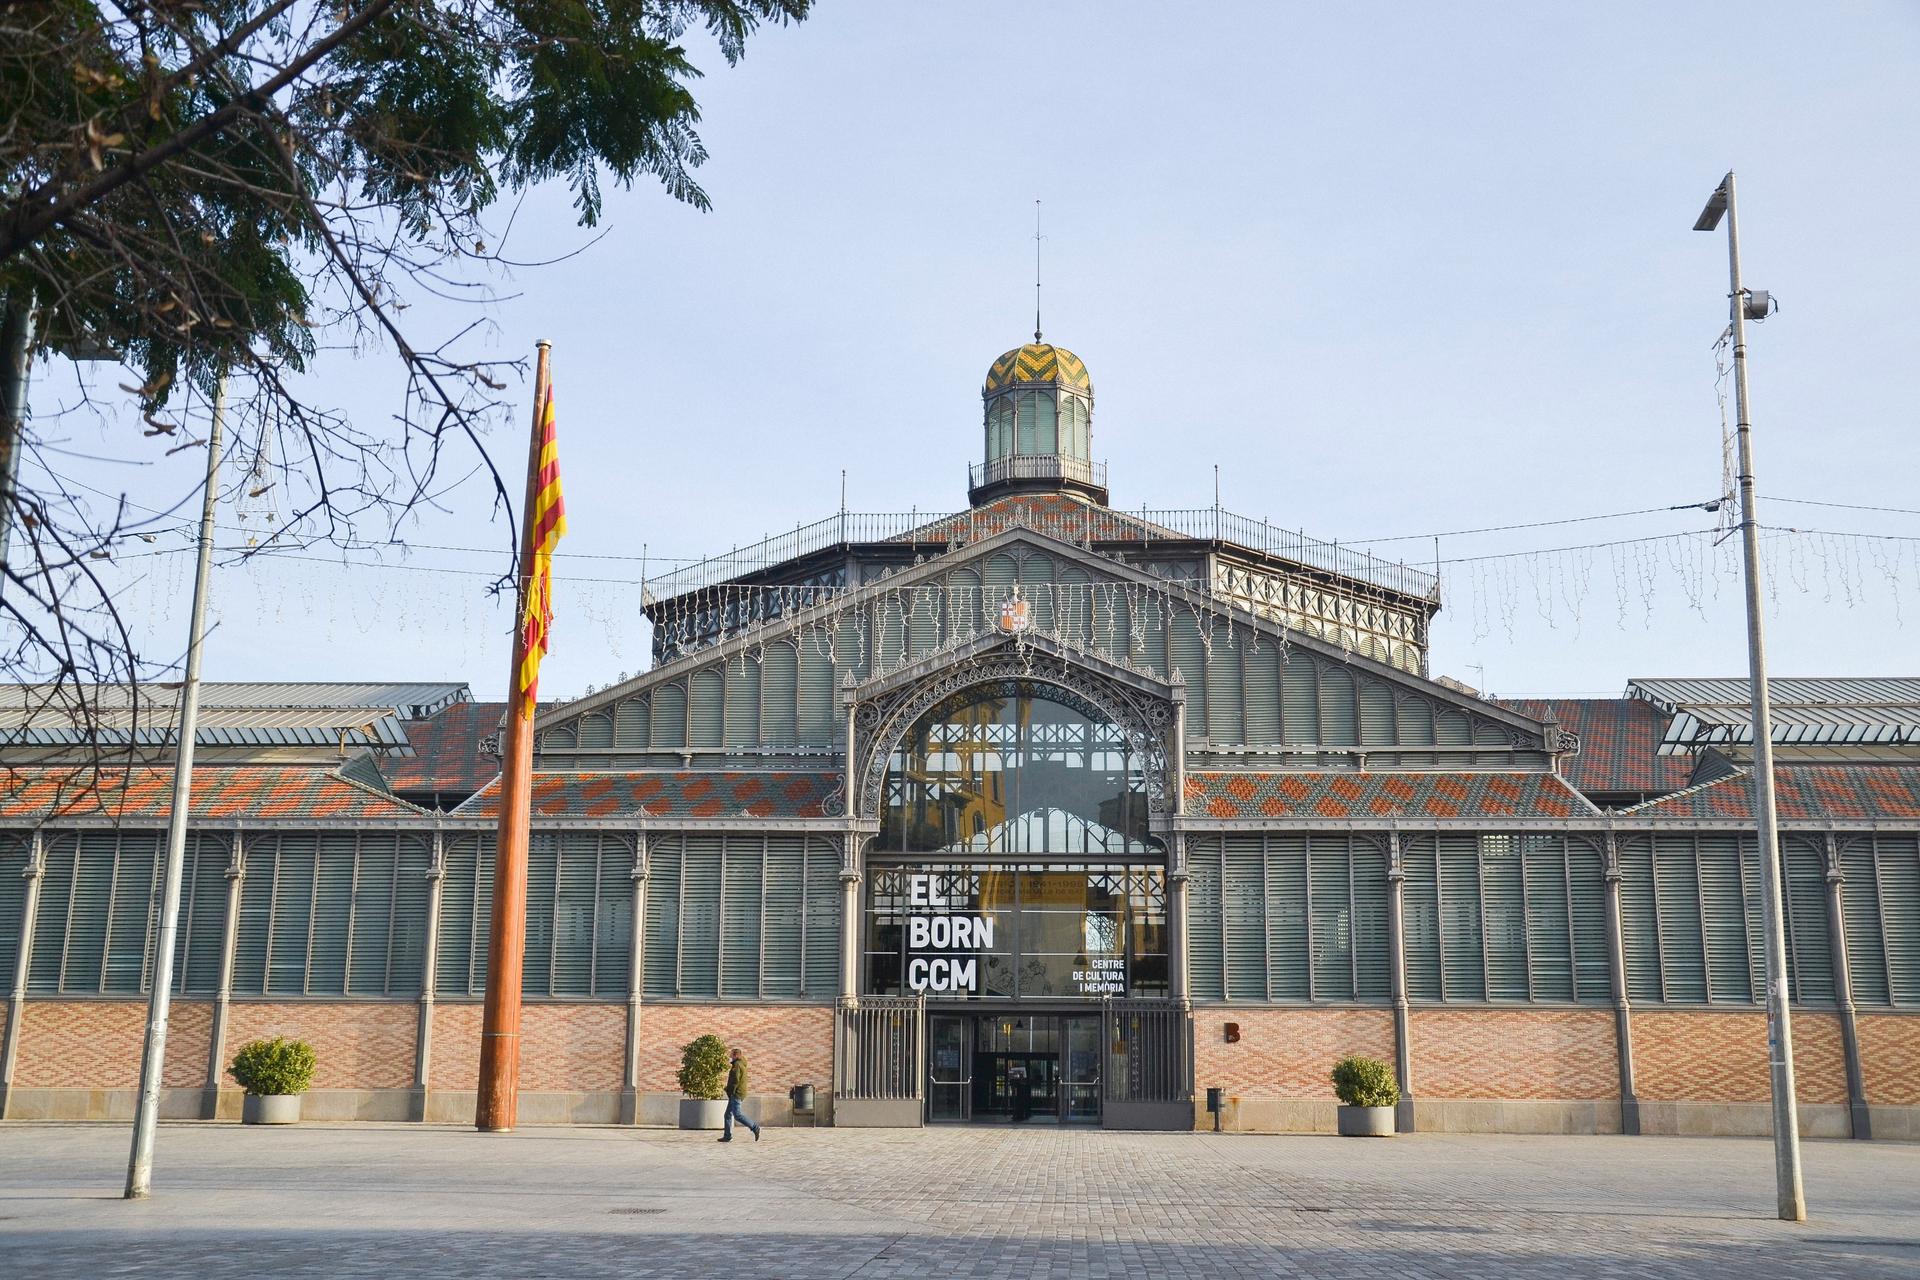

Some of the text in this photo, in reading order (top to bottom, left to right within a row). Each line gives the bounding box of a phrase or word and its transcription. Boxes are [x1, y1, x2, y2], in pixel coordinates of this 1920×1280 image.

[911, 874, 946, 906] EL
[910, 916, 994, 949] BORN
[909, 958, 977, 992] CCM
[1072, 971, 1125, 981] DE CULTURA
[1092, 959, 1125, 969] CENTRE
[1223, 1022, 1241, 1044] B
